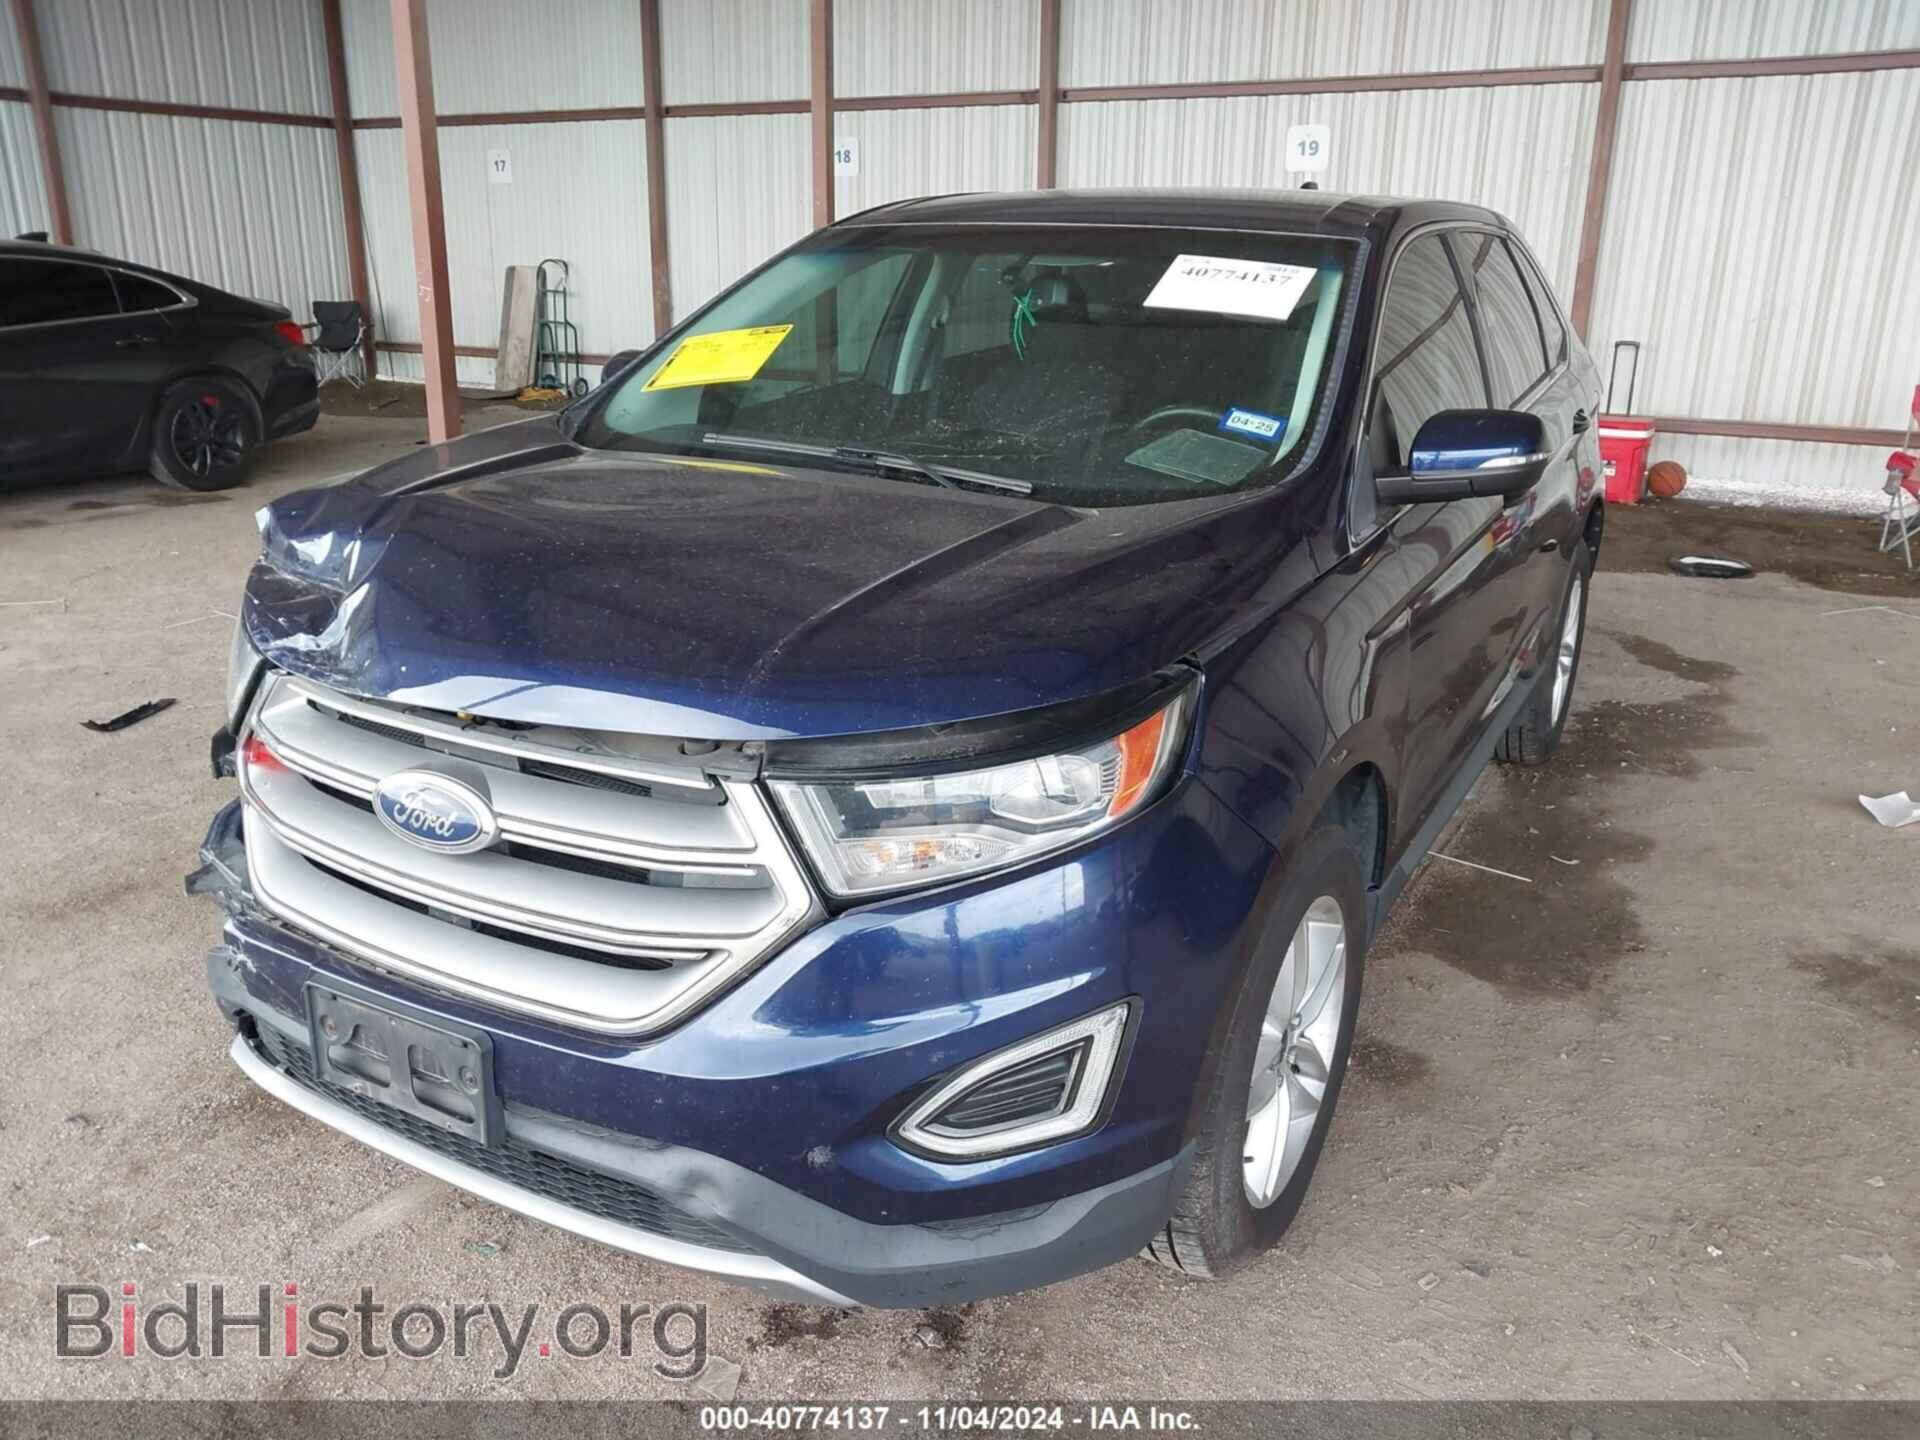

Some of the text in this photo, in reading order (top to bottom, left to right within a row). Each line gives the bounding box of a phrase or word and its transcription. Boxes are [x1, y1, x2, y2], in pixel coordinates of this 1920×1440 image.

[835, 150, 851, 163] 18
[1298, 140, 1319, 156] 19
[494, 160, 506, 171] 17
[1181, 266, 1293, 285] 40774137
[1231, 415, 1273, 433] 04-25
[393, 787, 459, 837] Ford
